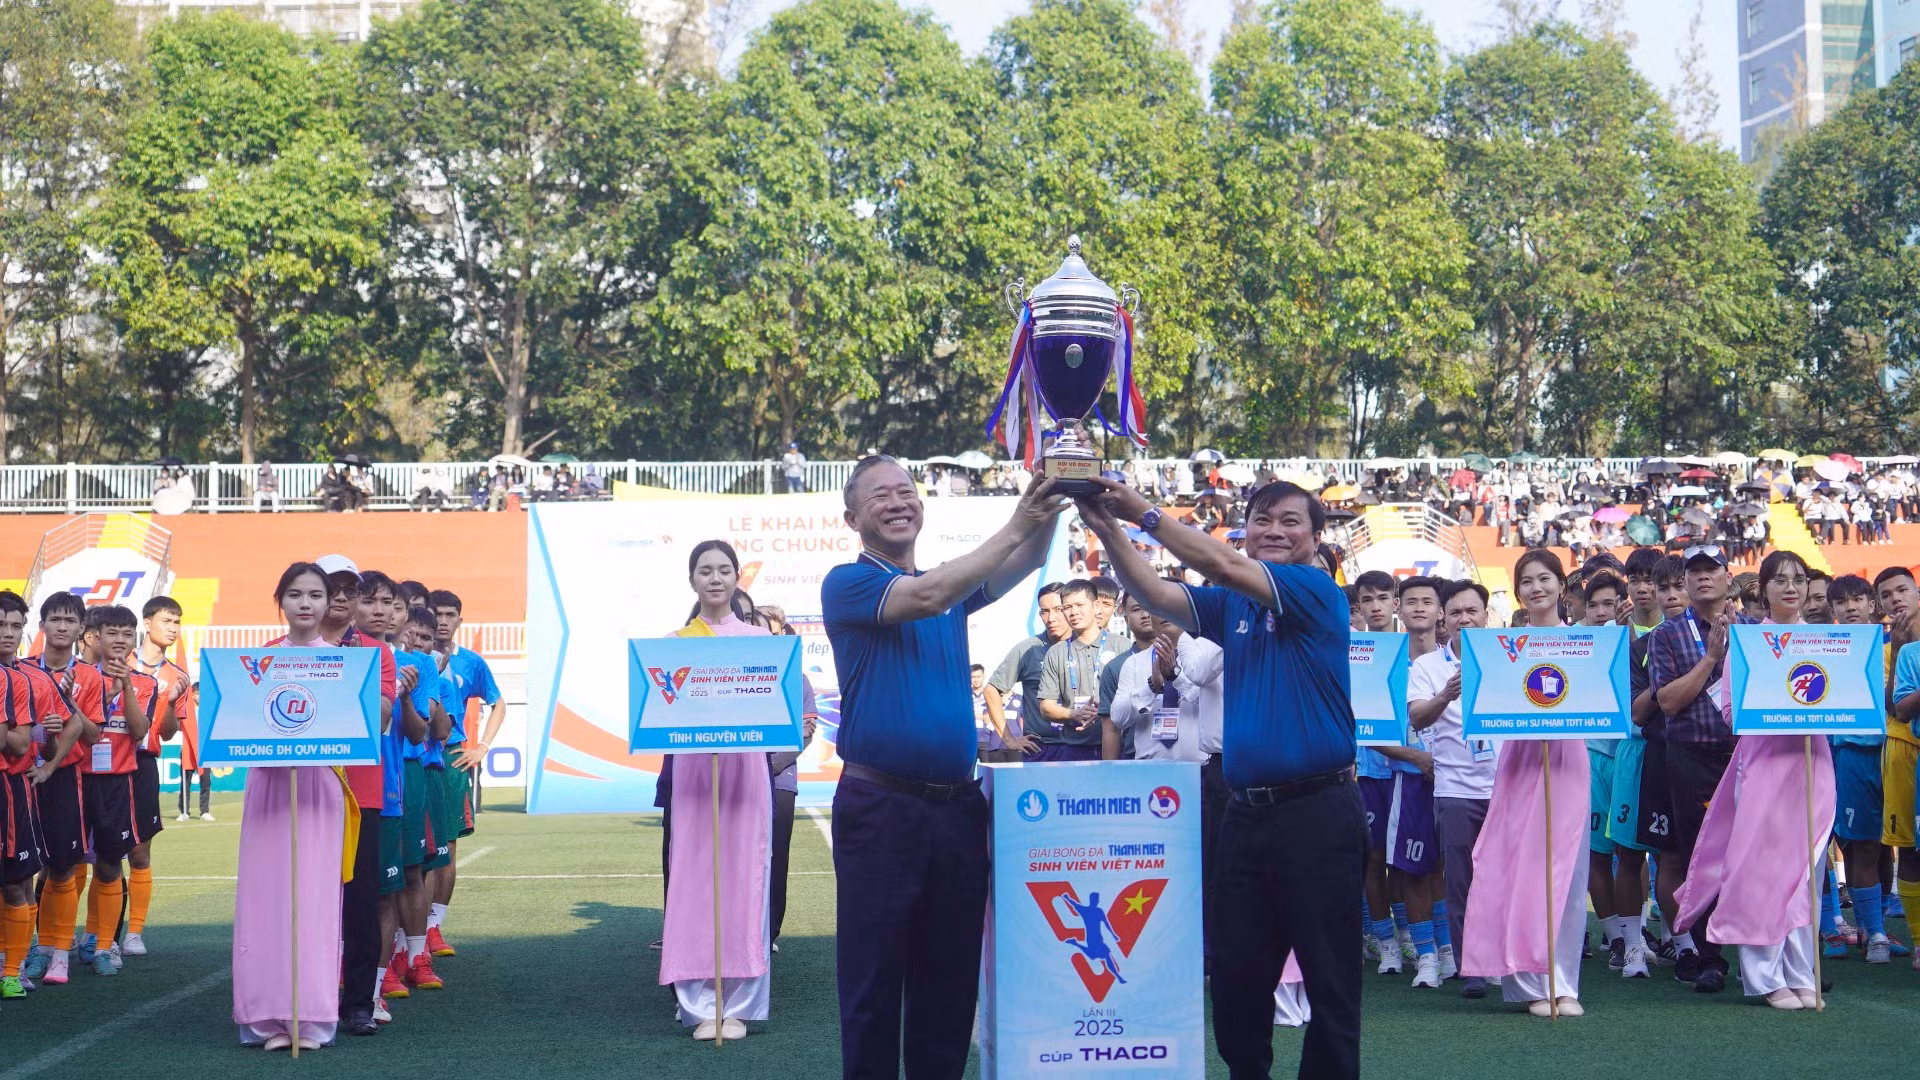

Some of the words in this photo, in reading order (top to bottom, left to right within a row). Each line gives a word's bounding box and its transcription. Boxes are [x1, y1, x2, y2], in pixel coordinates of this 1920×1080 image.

[761, 516, 813, 531] KHAI
[772, 537, 849, 552] CHUNG
[764, 575, 796, 585] SINH
[714, 675, 734, 683] VIÊN
[1516, 719, 1528, 728] ĐH
[740, 729, 763, 742] VIÊN
[228, 743, 273, 756] TRƯỜNG
[276, 744, 292, 755] ĐH
[295, 744, 318, 756] QUY
[1057, 798, 1106, 816] THANH
[1108, 796, 1141, 814] NIÊN
[1617, 804, 1631, 824] 3
[1845, 807, 1855, 828] 7
[1649, 812, 1669, 836] 23
[1108, 844, 1141, 856] THANH
[1142, 842, 1165, 855] NIÊN
[1406, 838, 1424, 862] 10
[1028, 861, 1062, 872] SINH
[1066, 859, 1097, 872] VIÊN
[1101, 858, 1131, 873] VIỆT
[1135, 859, 1165, 869] NAM
[1074, 1019, 1124, 1036] 2025
[1040, 1050, 1073, 1063] CÚP
[1079, 1045, 1167, 1061] THACO
